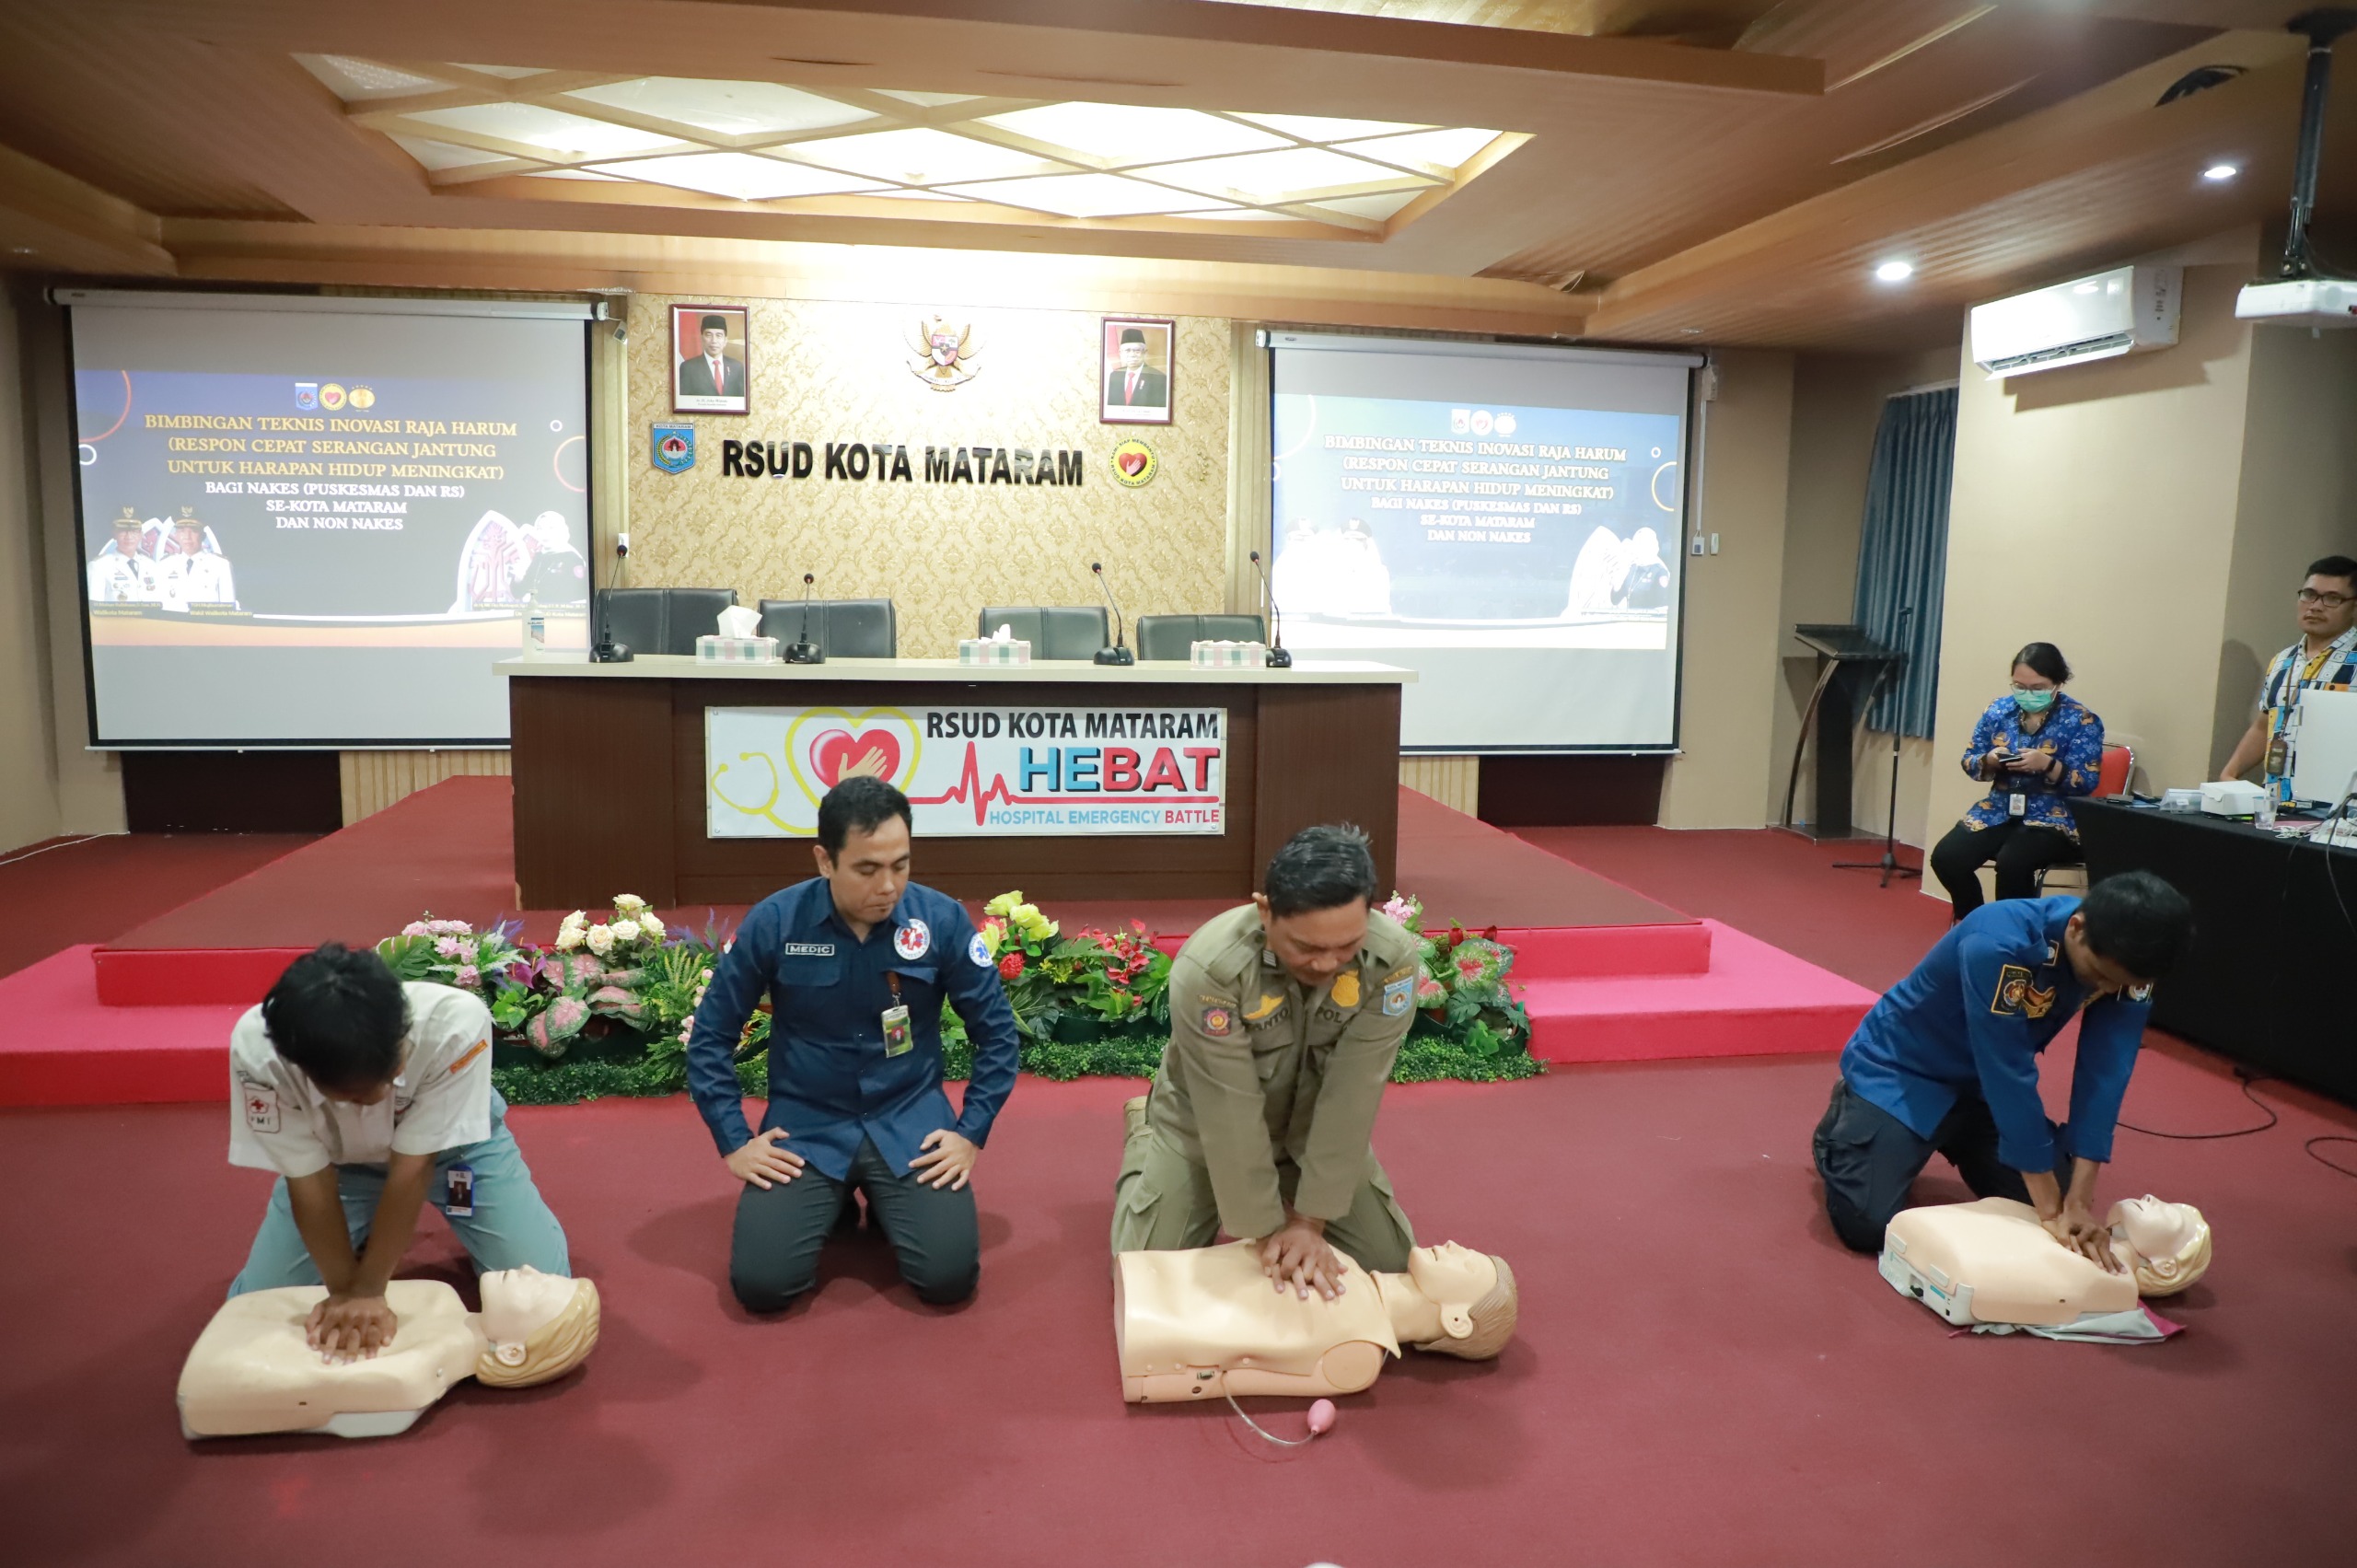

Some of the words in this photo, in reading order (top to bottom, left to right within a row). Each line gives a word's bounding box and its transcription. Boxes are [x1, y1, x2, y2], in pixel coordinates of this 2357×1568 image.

[145, 414, 253, 430] BIMBINGAN
[258, 416, 324, 432] TEKNIS
[331, 418, 401, 434] INOVASI
[405, 420, 447, 437] RAJA
[451, 422, 517, 436] HARUM
[168, 436, 247, 452] (RESPON
[250, 438, 307, 454] CEPAT
[311, 440, 409, 456] SERANGAN
[412, 442, 496, 459] JANTUNG
[1132, 438, 1155, 459] MEMBANTU
[1324, 435, 1415, 451] BIMBINGAN
[1419, 438, 1473, 454] TEKNIS
[1478, 442, 1535, 457] INOVASI
[1538, 445, 1571, 460] RAJA
[1574, 447, 1627, 461] HARUM
[167, 460, 234, 474] UNTUK
[238, 461, 323, 476] HARAPAN
[329, 463, 387, 477] HIDUP
[390, 464, 504, 480] MENINGKAT)
[723, 439, 813, 479] RSUD
[826, 442, 913, 482] KOTA
[925, 446, 1083, 486] MATARAM
[1342, 456, 1408, 471] (RESPON
[1412, 459, 1458, 473] CEPAT
[1461, 461, 1539, 477] SERANGAN
[1541, 464, 1609, 480] JANTUNG
[1136, 464, 1155, 485] MATARAM
[205, 482, 243, 494] BAGI
[247, 482, 299, 495] NAKES
[304, 482, 401, 496] (PUSKESMAS
[404, 484, 436, 497] DAN
[441, 485, 465, 498] RS)
[1341, 477, 1398, 492] UNTUK
[1400, 478, 1469, 494] HARAPAN
[1474, 482, 1521, 495] HIDUP
[1524, 483, 1614, 499] MENINGKAT)
[266, 499, 330, 513] SE-KOTA
[332, 500, 407, 514] MATARAM
[1371, 497, 1403, 509] BAGI
[1406, 498, 1449, 511] NAKES
[1452, 499, 1530, 514] (PUSKESMAS
[1533, 503, 1561, 514] DAN
[1562, 504, 1582, 516] RS)
[276, 517, 309, 528] DAN
[313, 517, 349, 529] NON
[352, 517, 403, 530] NAKES
[1421, 514, 1472, 527] SE-KOTA
[1475, 516, 1535, 528] MATARAM
[1427, 529, 1455, 541] DAN
[1458, 530, 1487, 542] NON
[1490, 531, 1531, 543] NAKES
[927, 712, 1001, 738] RSUD
[1008, 712, 1078, 738] KOTA
[1085, 713, 1218, 738] MATARAM
[1019, 747, 1220, 792] HEBAT
[990, 810, 1064, 824] HOSPITAL
[1068, 810, 1161, 824] EMERGENCY
[1165, 809, 1220, 823] BATTLE
[789, 945, 830, 954] MEDIC
